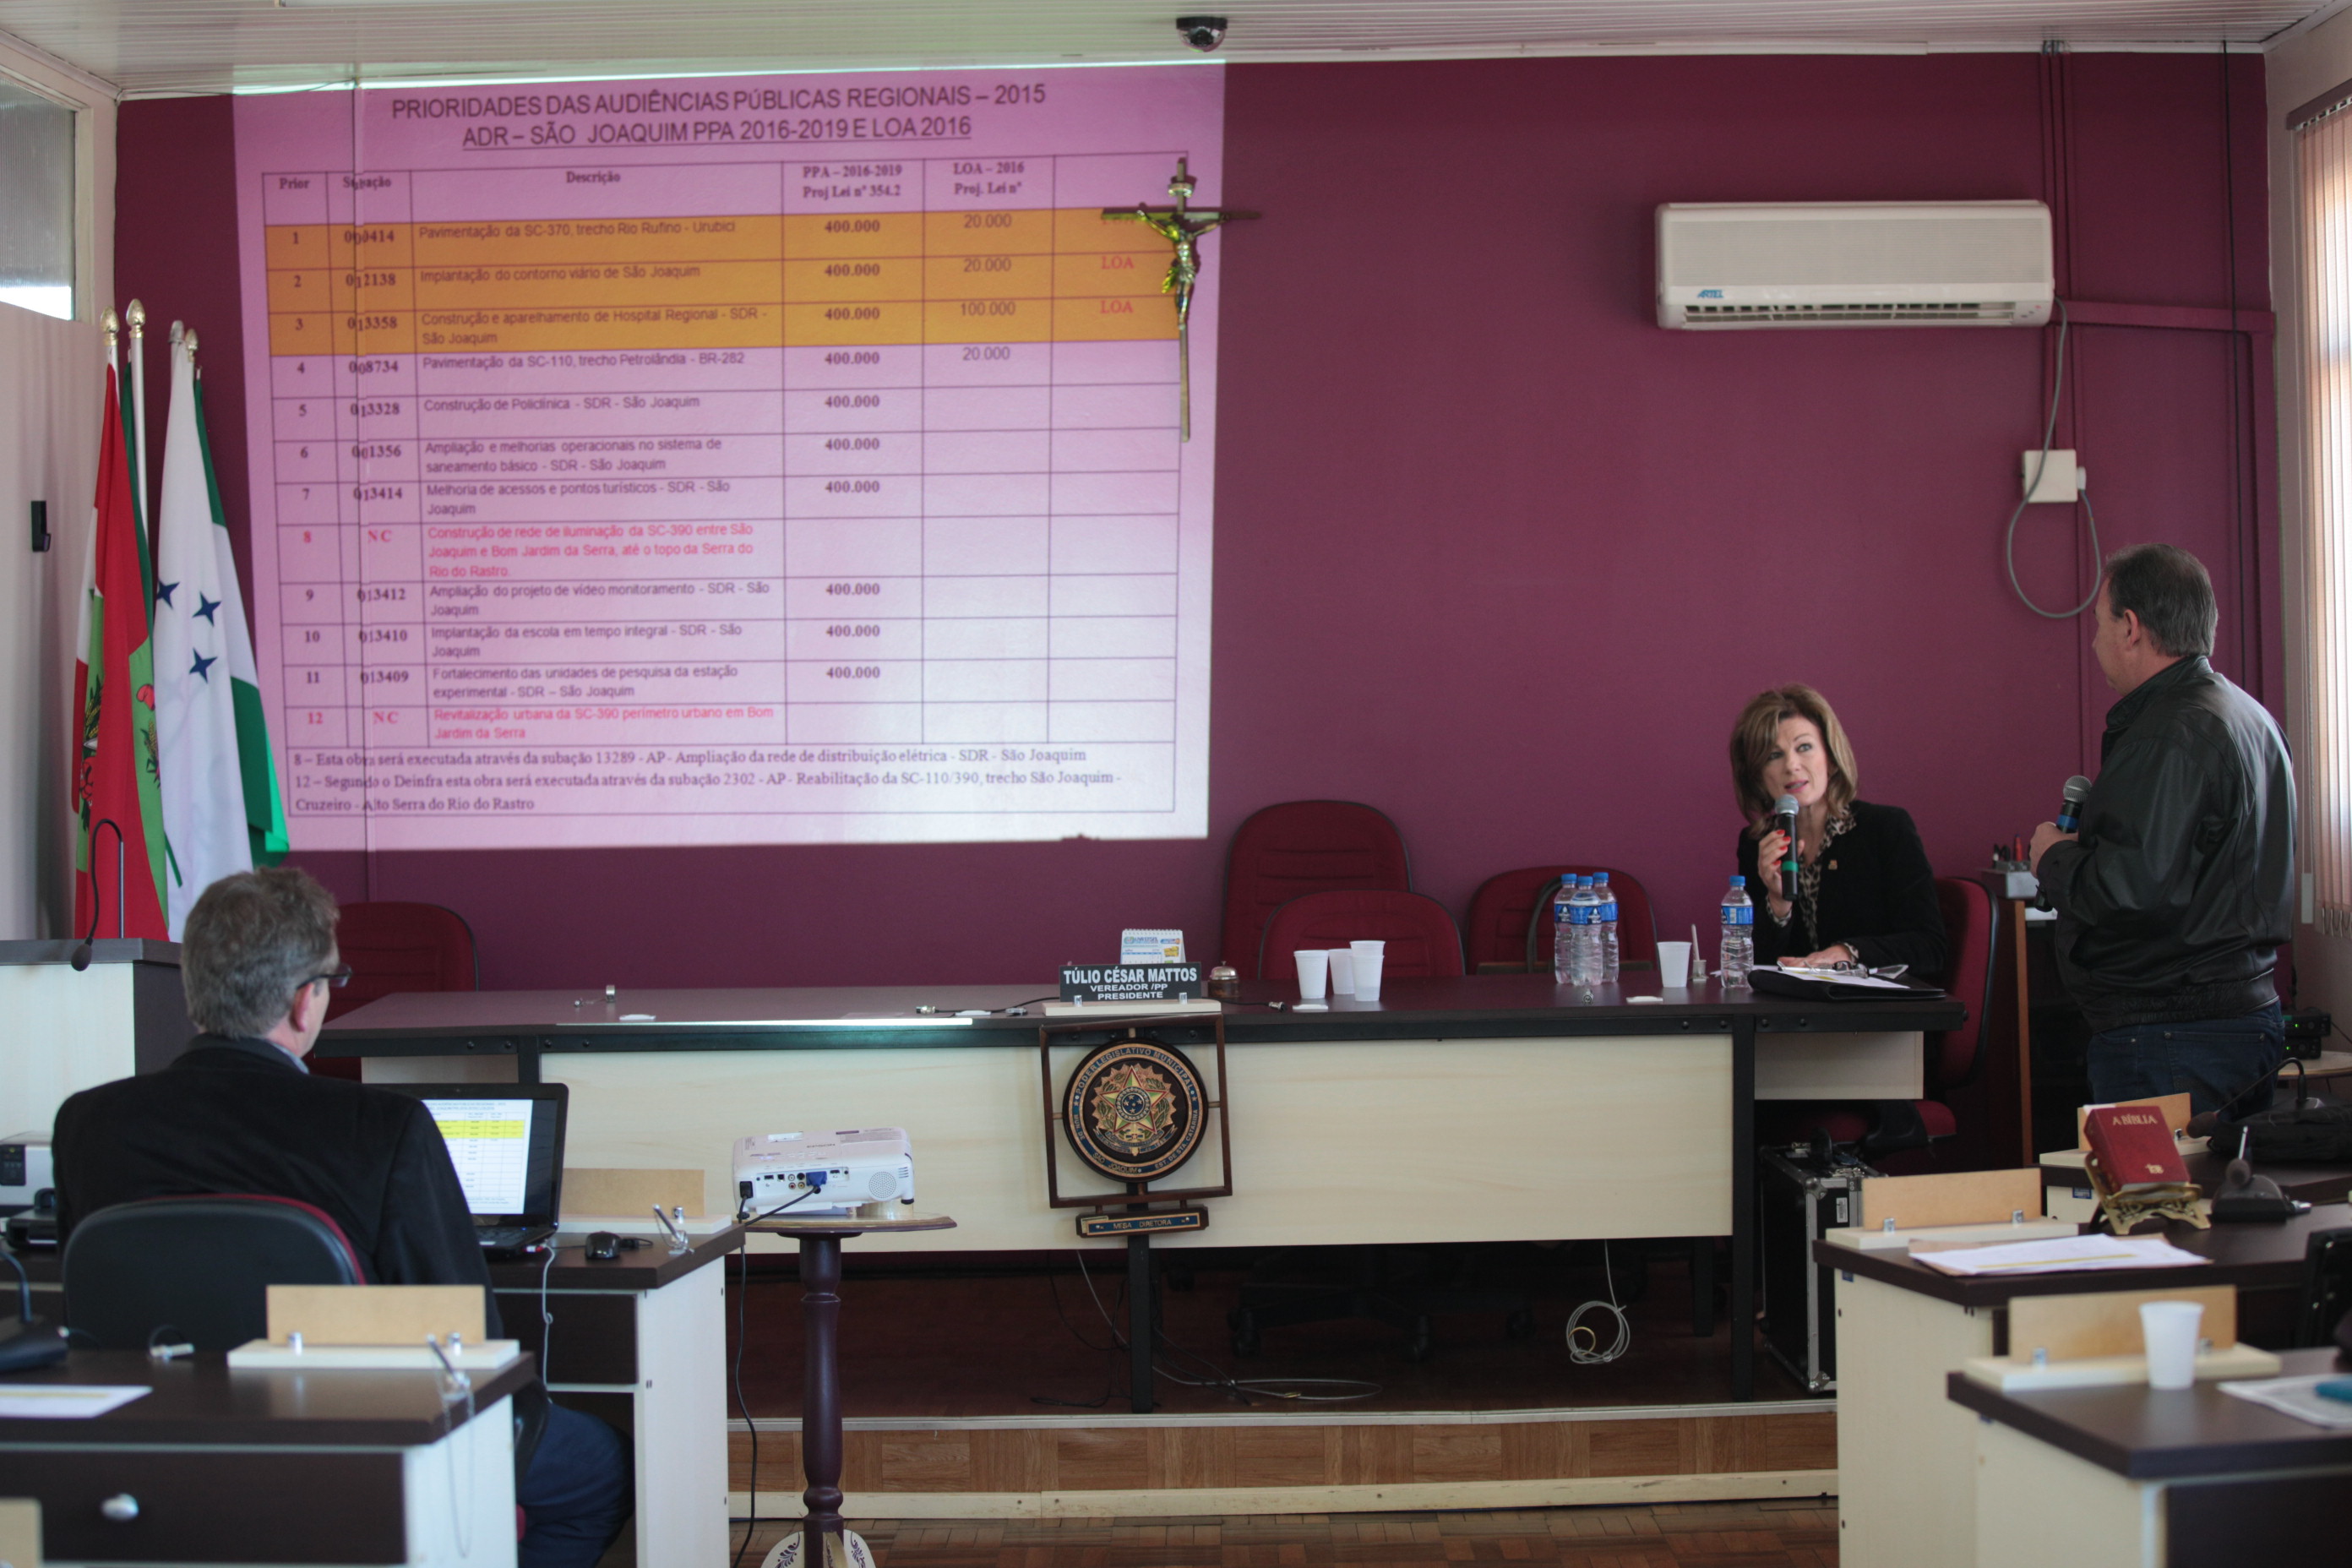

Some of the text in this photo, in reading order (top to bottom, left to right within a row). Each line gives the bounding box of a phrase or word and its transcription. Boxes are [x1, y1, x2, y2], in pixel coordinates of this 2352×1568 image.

[392, 83, 1046, 118] PRIORIDADES DAS AUDIÊNCIAS PÚBLICAS REGIONAIS 2015
[462, 115, 972, 146] ADR SÃO JOAQUIM PPA 2016-2019 E LOA 2016
[803, 163, 901, 178] PPA 2016-2019
[953, 161, 1024, 175] LOA 2016
[279, 177, 308, 189] Prior
[565, 169, 620, 186] Descrição
[831, 185, 851, 197] Lei
[870, 183, 901, 197] 354.2
[987, 182, 1006, 193] Lei
[825, 219, 879, 233] 400.000
[963, 213, 1012, 228] 20.000
[419, 223, 500, 241] Pavimentação
[576, 222, 615, 236] trecho
[618, 221, 637, 235] Rio
[640, 220, 681, 234] Rufino
[692, 220, 735, 233] Urubici
[963, 257, 1011, 272] 20.000
[1101, 255, 1134, 269] LOA
[421, 264, 700, 285] Implantação contorno viário São Joaquim
[825, 263, 879, 277] 400.000
[825, 306, 879, 320] 400.000
[961, 301, 1015, 316] 100.000
[1100, 299, 1133, 313] LOA
[421, 310, 489, 327] Construção
[612, 309, 661, 324] Hospital
[665, 307, 717, 324] Regional
[422, 331, 498, 346] São Joaquim
[825, 351, 879, 365] 400.000
[962, 346, 1010, 361] 20.000
[422, 356, 504, 372] Pavimentação
[578, 355, 617, 367] trecho
[619, 352, 686, 366] Petrolândia
[699, 352, 744, 365] BR-282
[423, 397, 491, 414] Construção
[583, 396, 611, 409] SDR
[623, 395, 645, 408] São
[652, 396, 700, 410] Joaquim
[825, 395, 879, 408] 400.000
[425, 438, 702, 455] Ampliação melhorias operacionais sistema
[825, 437, 879, 451] 400.000
[426, 460, 537, 472] saneamento básico
[426, 482, 656, 497] Melhoria acessos pontos turísticos
[825, 480, 879, 493] 400.000
[428, 504, 476, 516] Joaquim
[429, 583, 694, 599] Ampliação projeto vídeo monitoramento
[826, 582, 879, 596] 400.000
[305, 630, 320, 643] 10
[431, 624, 667, 640] Implantação escola tempo integral
[827, 624, 879, 637] 400.000
[307, 671, 319, 683] 11
[433, 664, 738, 680] Fortalecimento unidades pesquisa estação
[827, 666, 879, 679] 400.000
[433, 687, 507, 700] experimental
[308, 711, 323, 724] 12
[542, 748, 1086, 766] subação 13289 Ampliação rede distribuição elétrica São Joaquim
[394, 774, 443, 787] Deinfra
[506, 774, 531, 787] será
[535, 773, 599, 787] executada
[602, 773, 647, 786] através
[669, 772, 720, 788] subação
[723, 772, 754, 785] 2302
[796, 771, 879, 787] Reabilitação
[295, 798, 534, 811] Cruzeiro Serra Rastro
[1064, 966, 1196, 983] TÚLIO CÉSAR MATTOS
[1090, 983, 1148, 992] VEREADOR
[1098, 992, 1163, 1000] PRESIDENTE
[1076, 1048, 1194, 1093] PODER LEGISLATIVO MUNICIPAL
[2121, 1113, 2158, 1125] BÍBLIA
[1108, 1162, 1137, 1173] JOAQUIM
[1186, 1109, 1198, 1141] CATARINA
[1113, 1219, 1171, 1230] MESA DIRETORA
